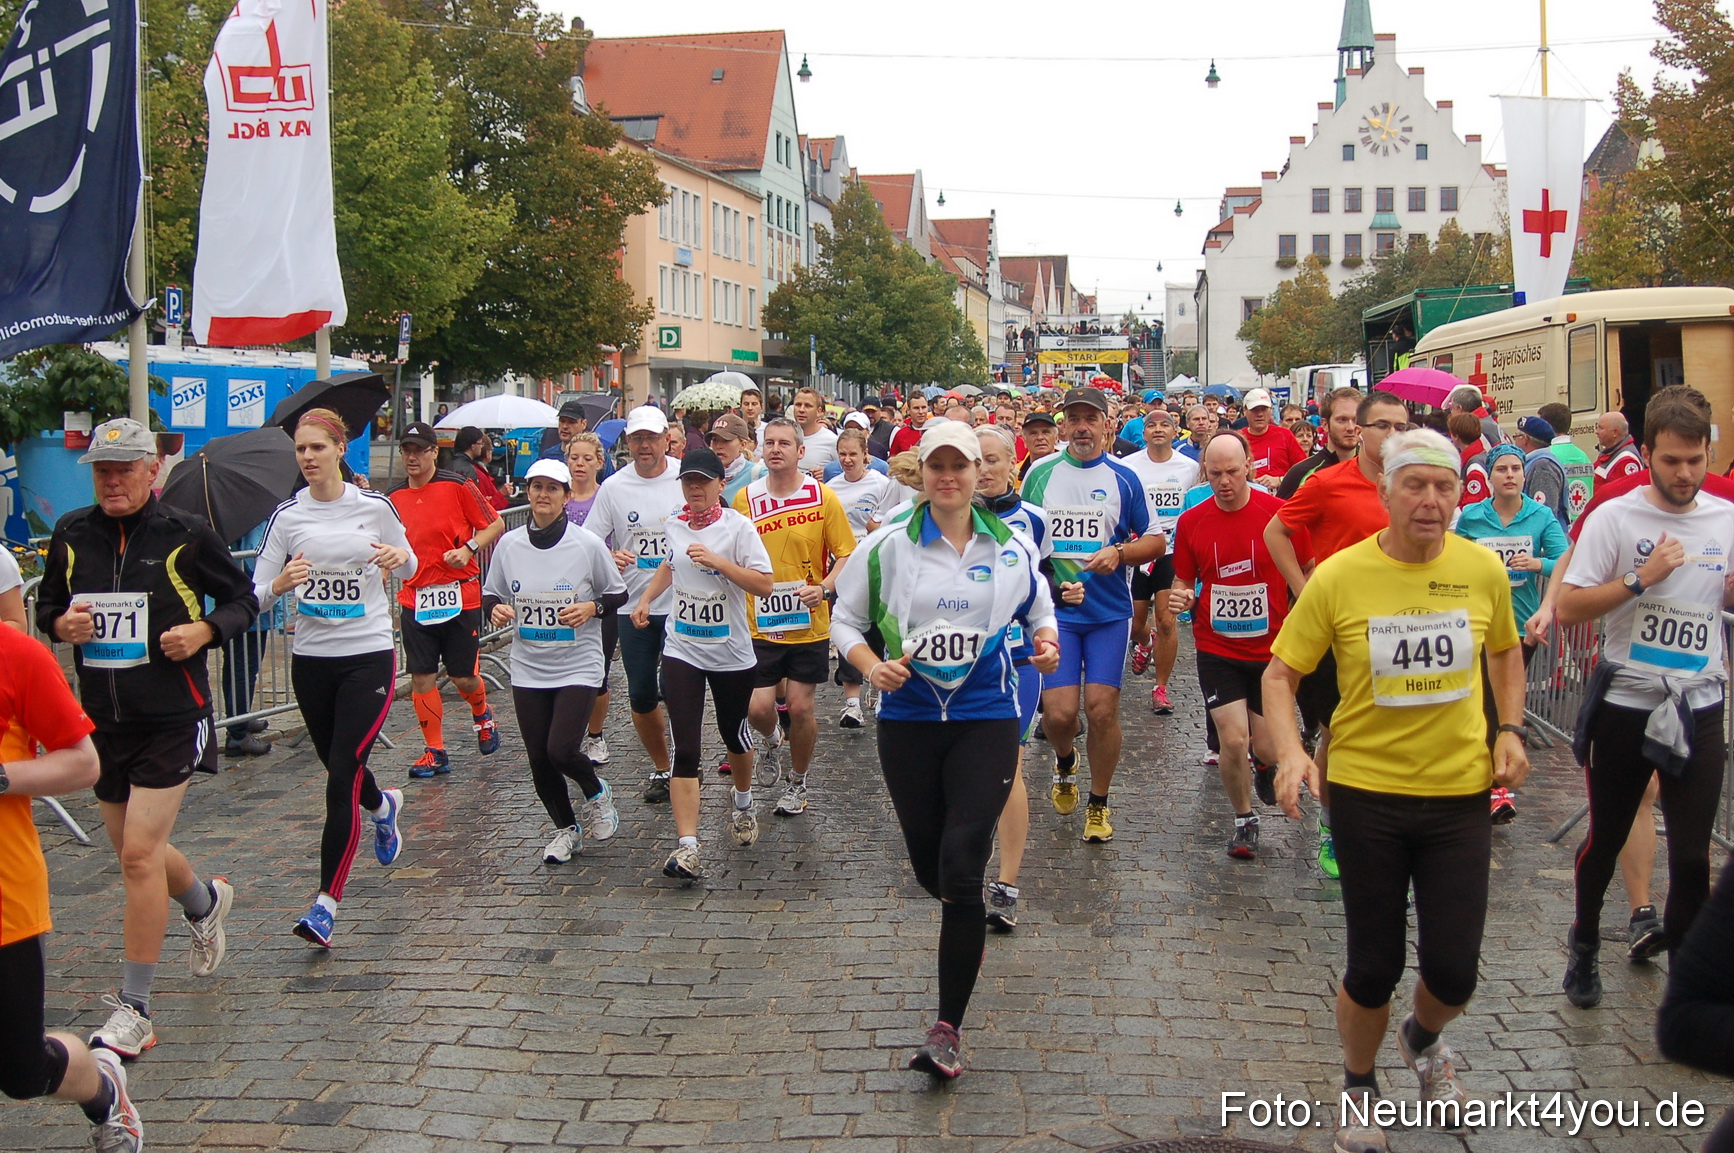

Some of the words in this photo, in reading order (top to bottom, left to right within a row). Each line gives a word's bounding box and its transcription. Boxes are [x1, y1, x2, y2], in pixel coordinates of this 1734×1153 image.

[170, 292, 179, 320] P
[662, 330, 678, 346] D
[1492, 344, 1542, 371] Bayerisches
[1492, 372, 1514, 392] Rotes
[1568, 424, 1594, 437] ayerisches
[787, 511, 824, 526] BÖGL
[1052, 518, 1098, 538] 2815
[1064, 543, 1082, 551] Jens
[303, 578, 360, 600] 2395
[676, 590, 690, 600] PARTL
[691, 594, 718, 602] Neumarkt
[420, 590, 457, 608] 2189
[760, 593, 801, 613] 3007
[936, 597, 968, 612] Anja
[314, 606, 346, 616] Marina
[678, 600, 724, 623] 2140
[1216, 597, 1263, 618] 2328
[1638, 602, 1667, 614] PARTL
[1669, 607, 1704, 620] Neumarkt
[91, 612, 136, 639] 971
[767, 616, 798, 626] Christian
[1227, 622, 1252, 630] Robert
[1372, 626, 1404, 635] PARTL
[1406, 622, 1452, 632] Neumarkt
[535, 632, 556, 640] Astrid
[686, 626, 713, 636] Renate
[1640, 614, 1708, 651] 3069
[94, 646, 124, 657] Hubert
[912, 632, 979, 662] 2801
[1392, 634, 1454, 670] 449
[936, 670, 957, 682] Anja
[1406, 678, 1442, 692] Heinz
